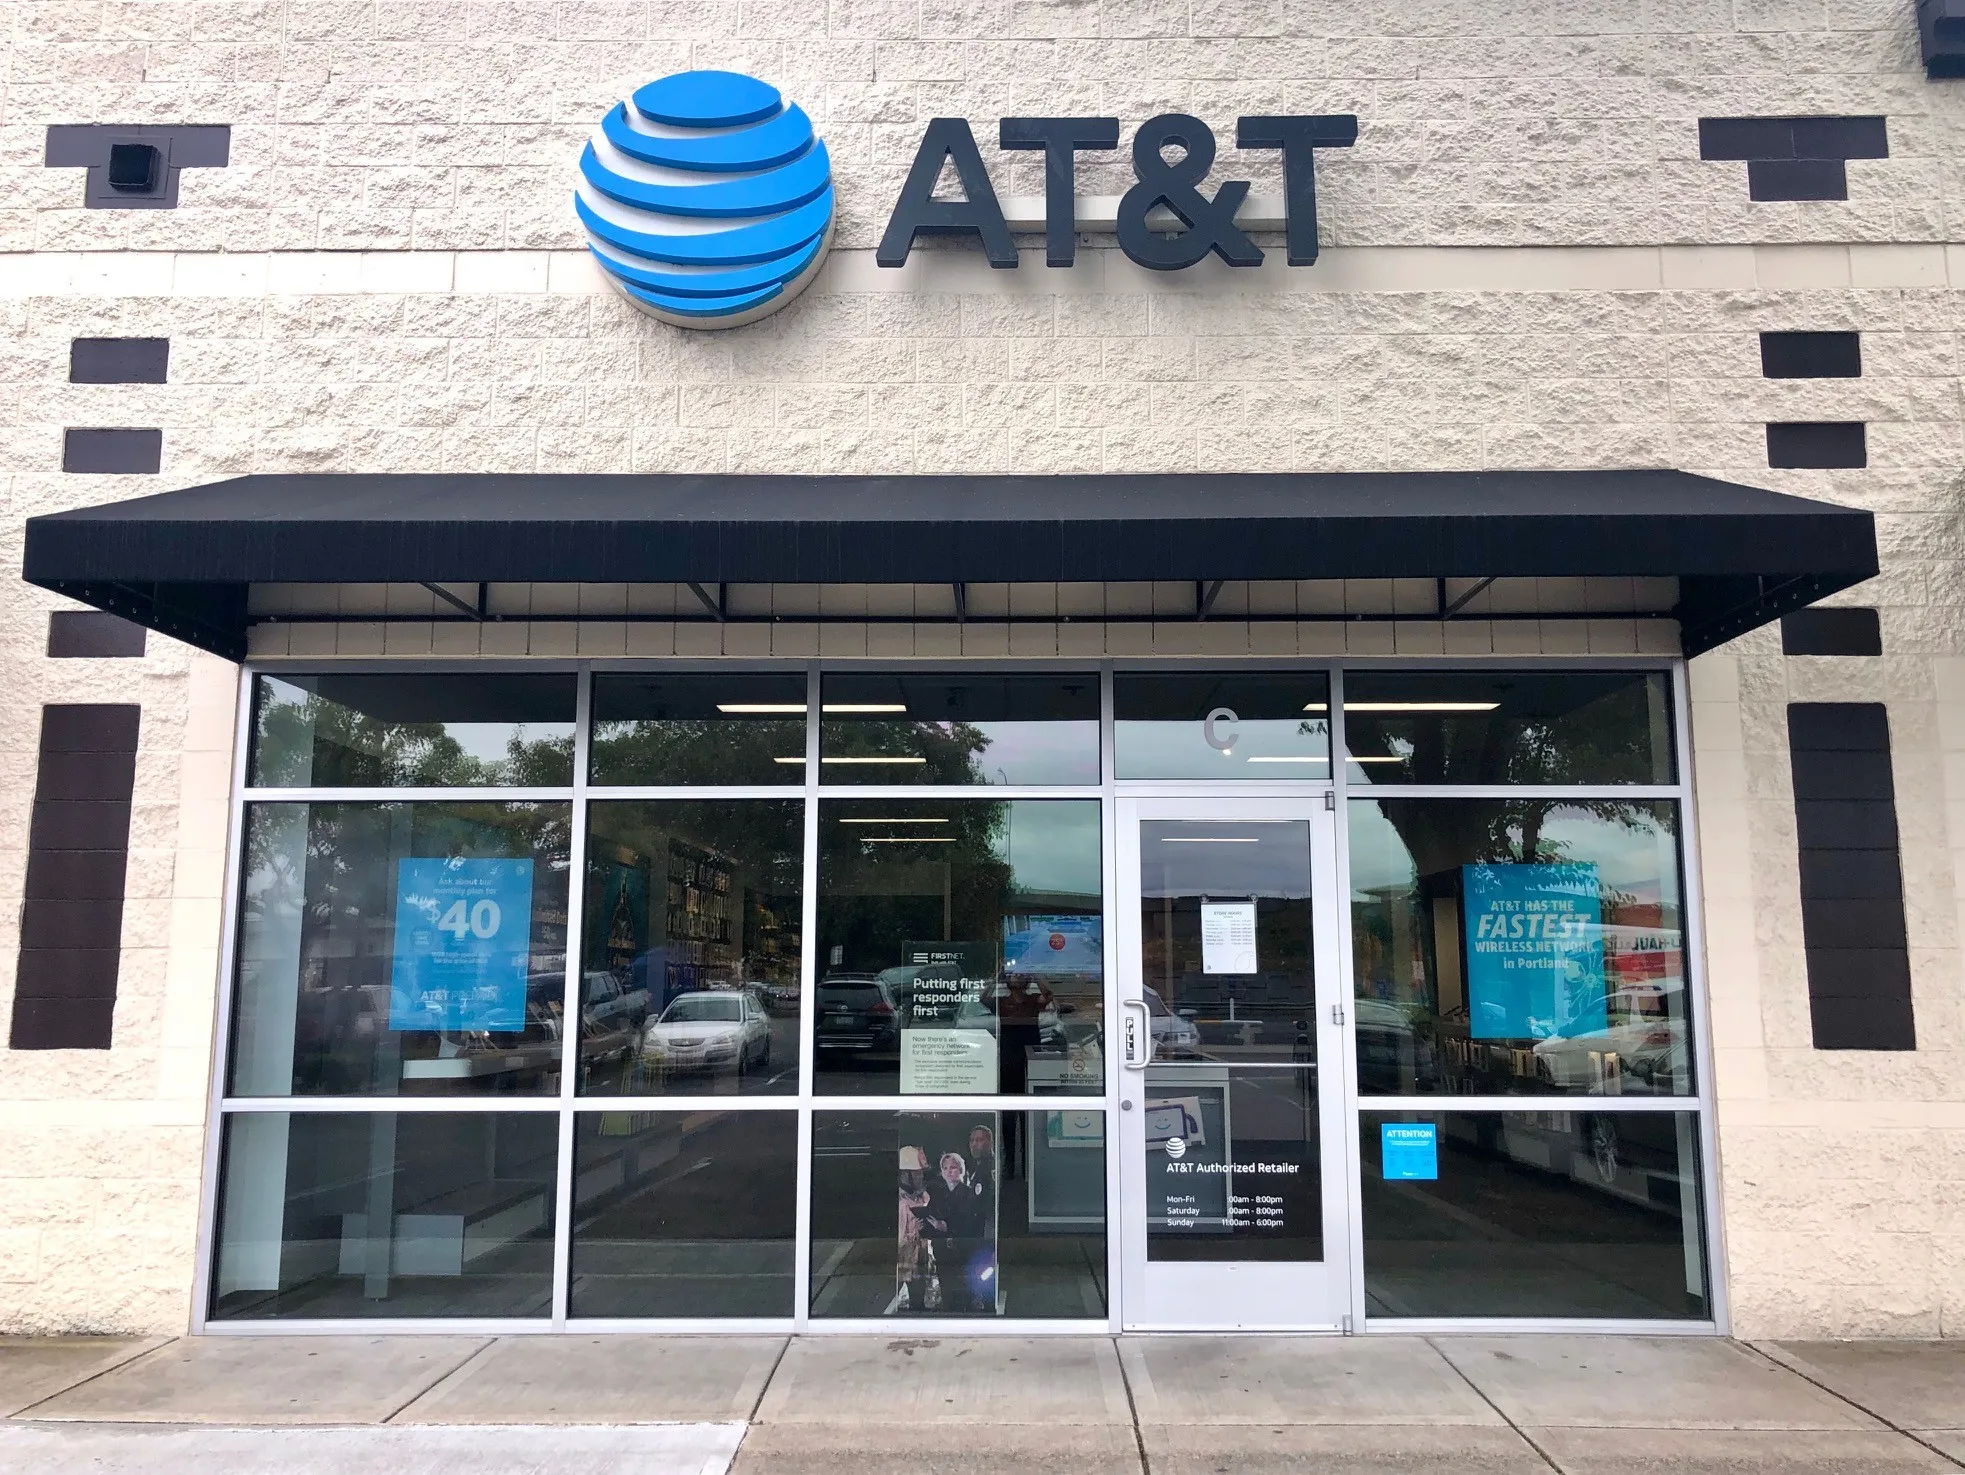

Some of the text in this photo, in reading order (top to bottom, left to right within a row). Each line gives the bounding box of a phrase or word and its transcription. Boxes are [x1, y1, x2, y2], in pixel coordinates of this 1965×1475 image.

[876, 113, 1358, 271] AT&T
[1204, 707, 1240, 750] C
[1490, 900, 1574, 912] AT&T HAS THE
[426, 899, 501, 939] $40
[1477, 913, 1592, 938] FASTEST
[1475, 941, 1595, 953] WIRELESS NETWORK
[1503, 957, 1570, 969] in Portland
[913, 978, 985, 991] Putting first
[421, 990, 449, 1000] AT&T
[913, 992, 980, 1004] responders
[913, 1005, 939, 1016] first
[1126, 1019, 1134, 1050] PULL
[1386, 1129, 1433, 1138] ATTENTION
[1166, 1162, 1300, 1173] AT&T Authorized Retailer
[1166, 1195, 1195, 1203] Mon-Fri
[1255, 1195, 1283, 1205] 8:00pm
[1166, 1206, 1200, 1216] Saturday
[1255, 1206, 1284, 1216] 8:00pm
[1167, 1218, 1195, 1228] Sunday
[1221, 1218, 1251, 1226] 11:00am
[1256, 1218, 1284, 1228] 6:00pm
